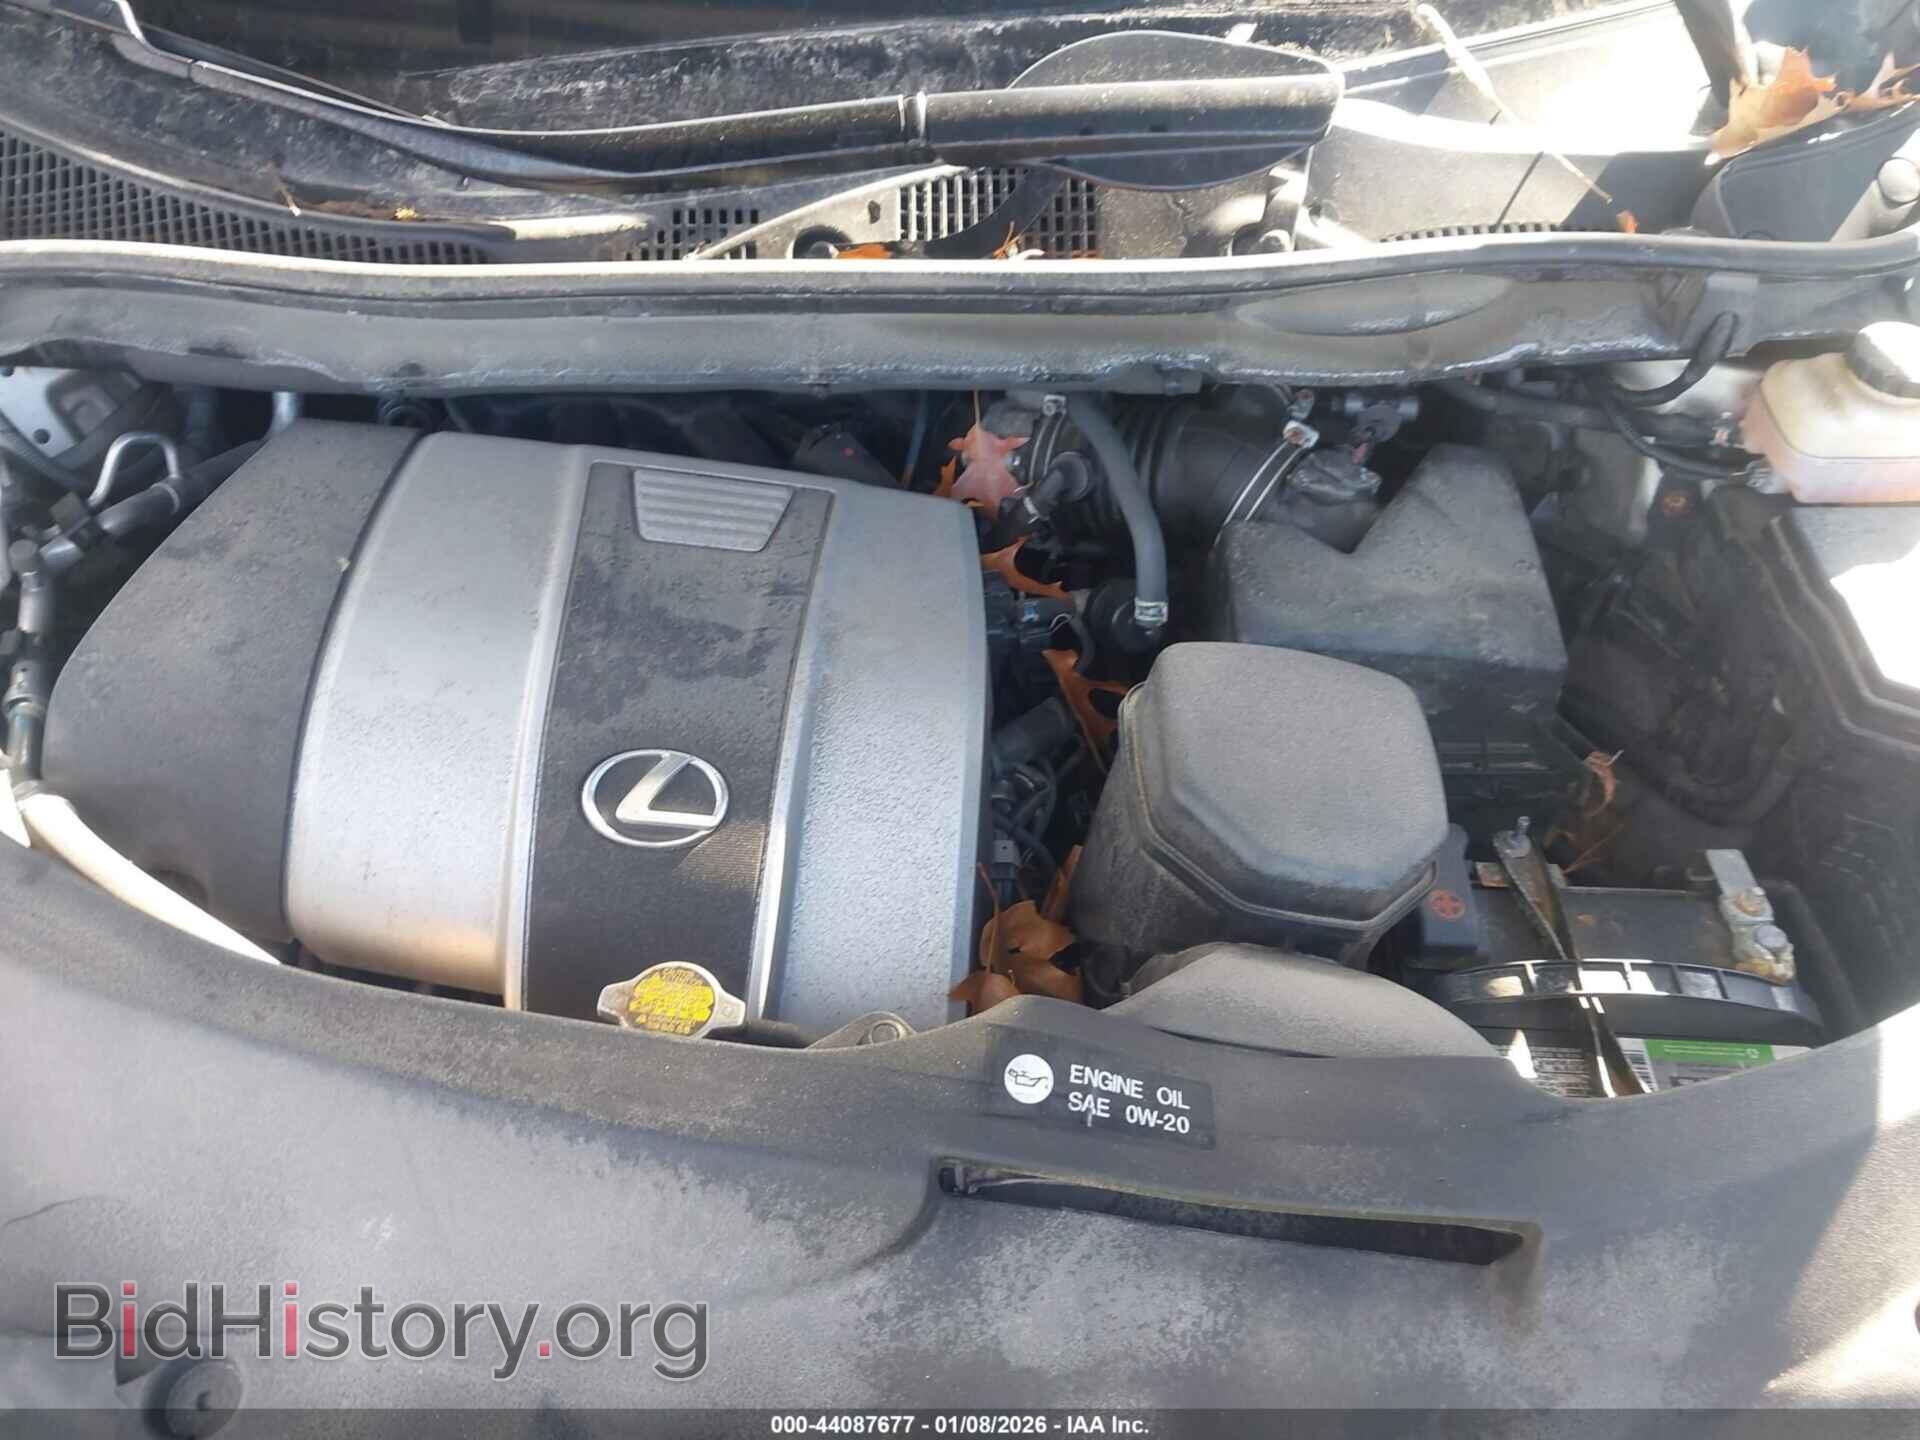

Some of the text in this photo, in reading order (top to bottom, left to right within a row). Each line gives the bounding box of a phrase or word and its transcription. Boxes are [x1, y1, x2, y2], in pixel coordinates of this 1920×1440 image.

[1070, 1064, 1191, 1110] ENGINE OIL
[1068, 1092, 1190, 1133] SAE 0W-20
